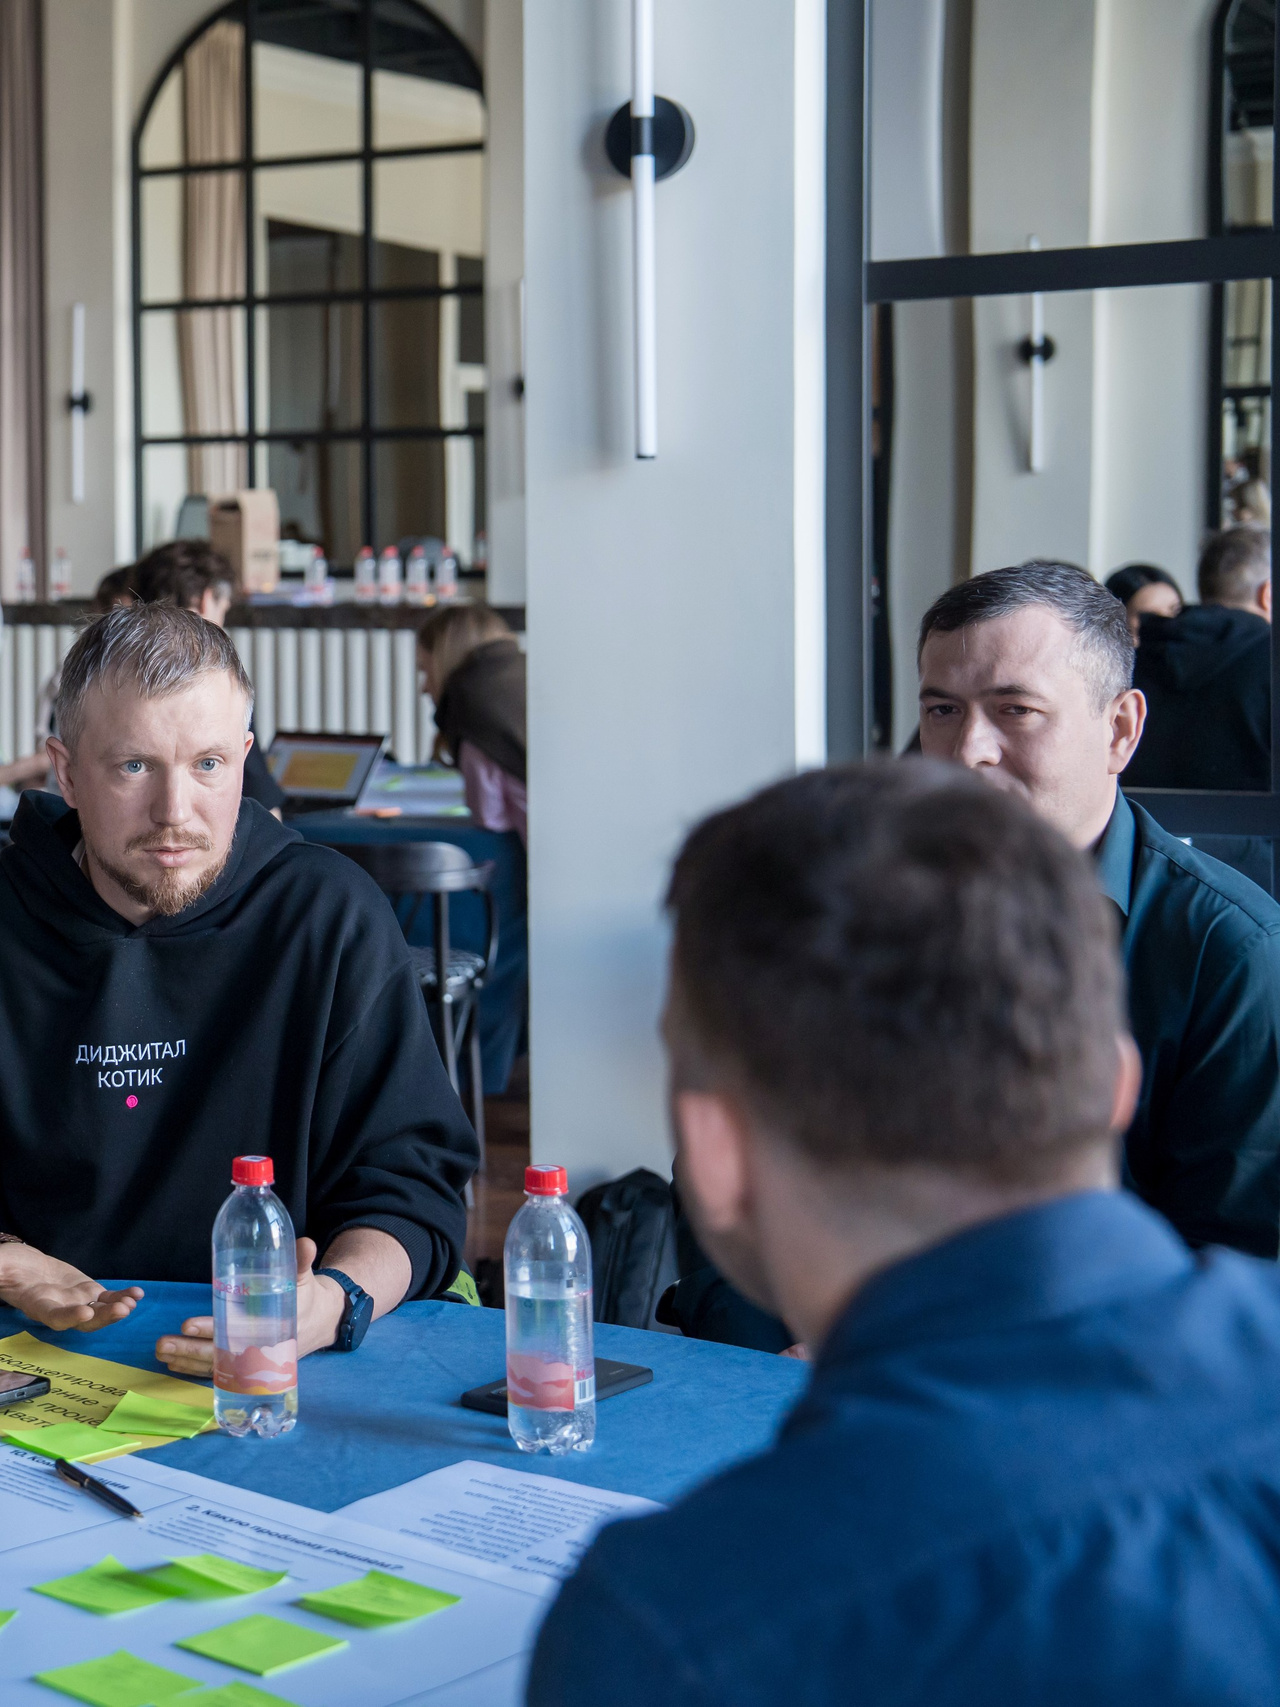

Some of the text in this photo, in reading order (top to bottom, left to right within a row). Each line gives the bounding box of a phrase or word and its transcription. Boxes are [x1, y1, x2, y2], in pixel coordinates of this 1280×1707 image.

[75, 1039, 186, 1066] ДИДЖИТАЛ
[98, 1067, 163, 1088] КОТИК
[202, 1508, 250, 1527] Какую
[251, 1525, 325, 1551] проблему
[323, 1547, 404, 1571] решаем?
